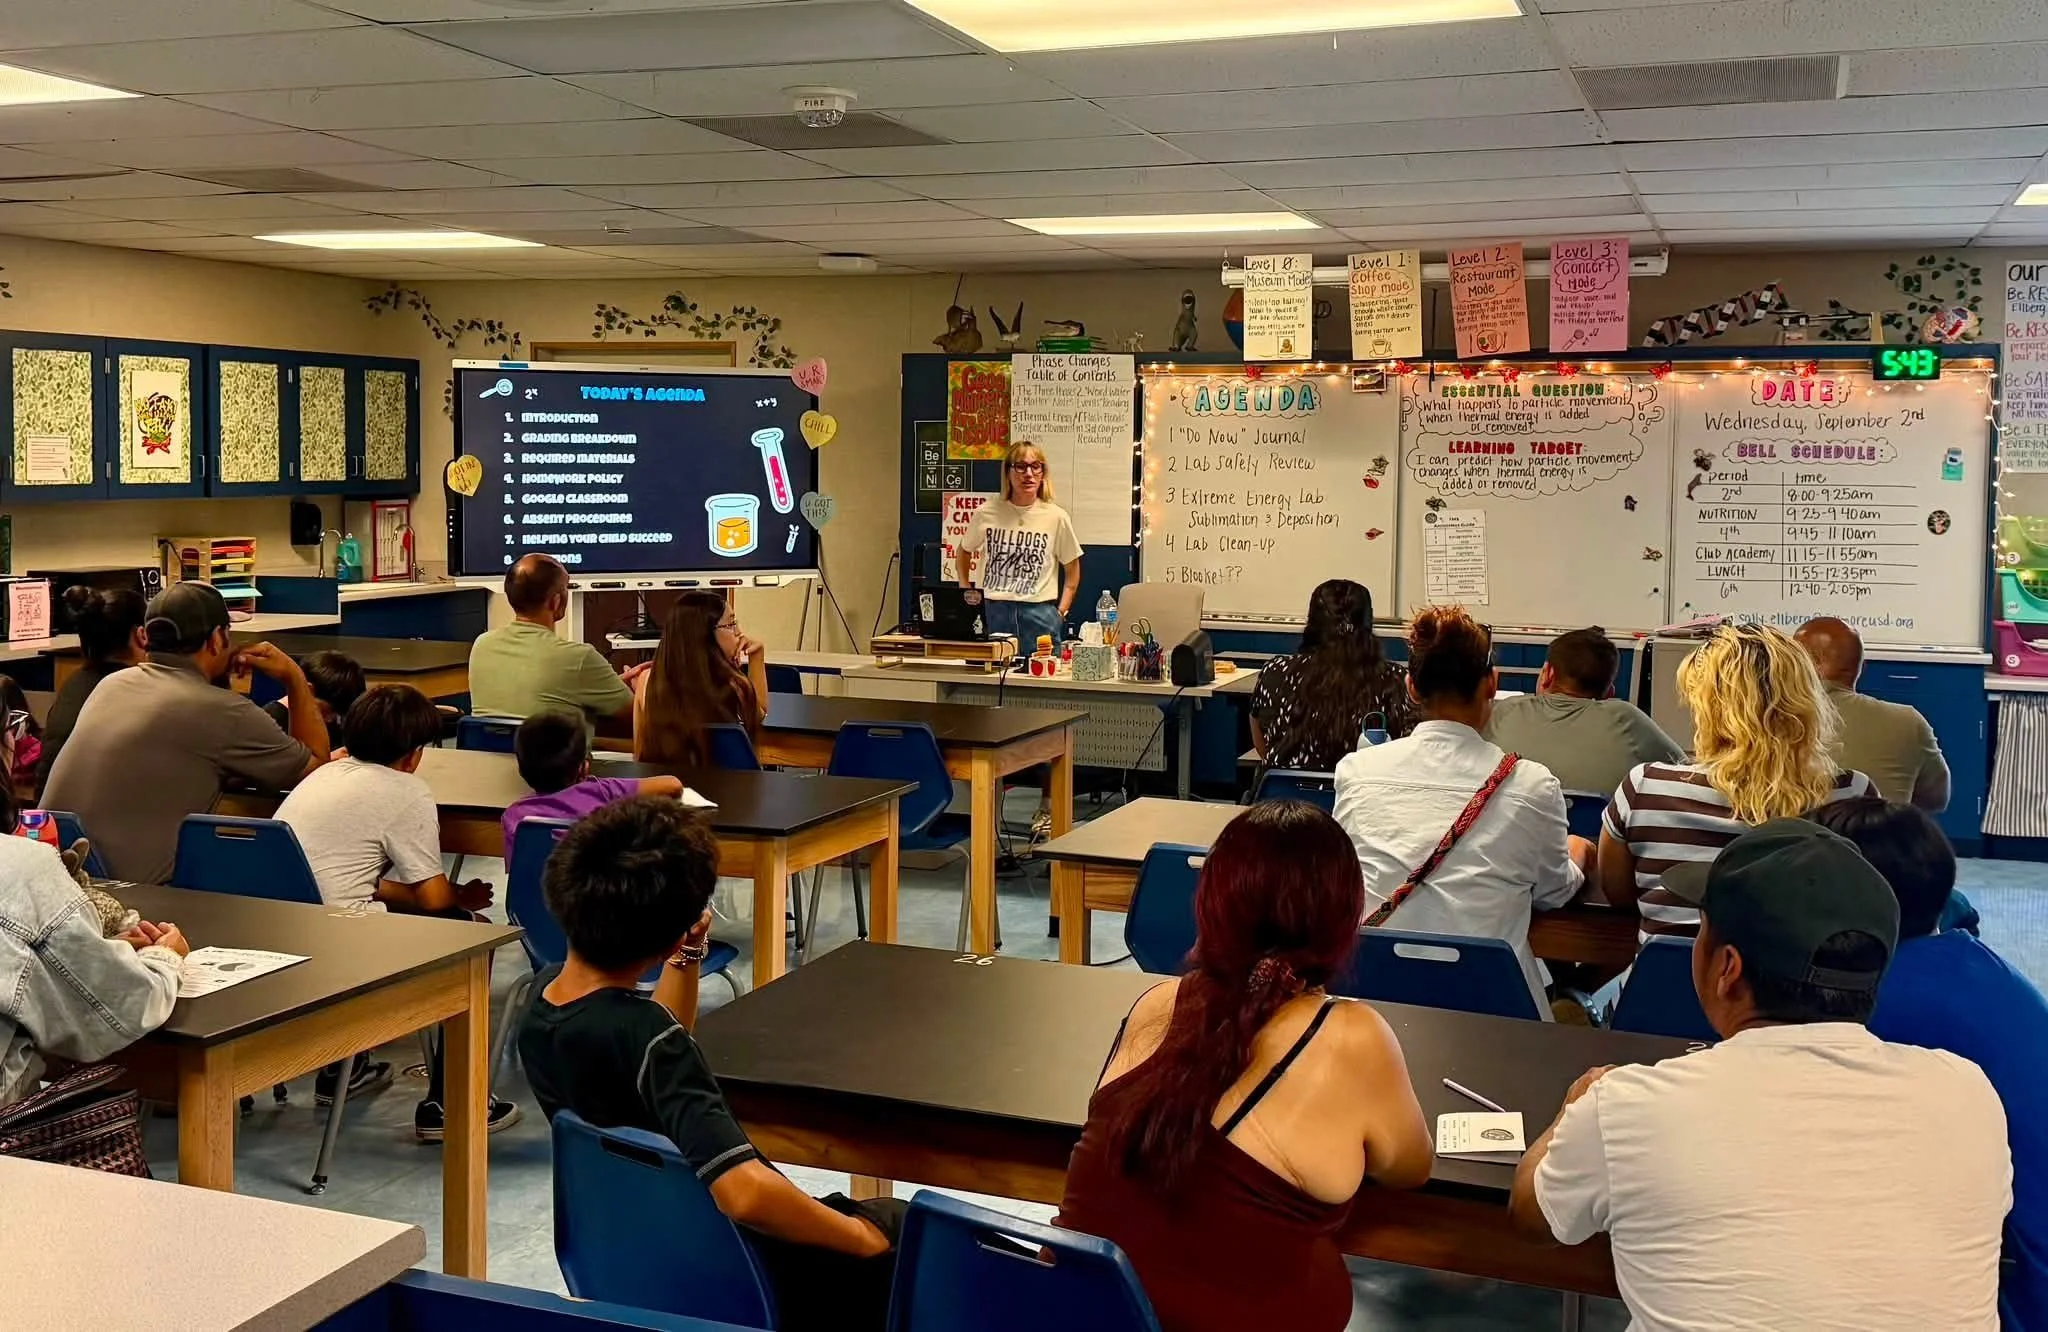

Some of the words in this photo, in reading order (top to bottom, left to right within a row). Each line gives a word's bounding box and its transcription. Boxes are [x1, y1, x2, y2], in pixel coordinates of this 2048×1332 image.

[1452, 250, 1486, 266] Level
[1496, 247, 1509, 261] 2:
[1557, 244, 1592, 259] Level
[1601, 242, 1616, 257] 3:
[1245, 257, 1275, 272] Level
[1352, 254, 1389, 269] Level
[1397, 253, 1411, 267] 1:
[1562, 260, 1614, 274] Concert
[1247, 275, 1285, 287] Museum
[1288, 274, 1311, 287] Mode
[1352, 271, 1391, 283] Coffee
[1453, 266, 1516, 284] Restaurant
[1568, 276, 1595, 289] Mode
[1352, 285, 1376, 296] Shop
[1381, 281, 1409, 293] mode
[1468, 283, 1494, 297] Mode
[2008, 287, 2025, 300] Be
[2006, 322, 2023, 338] Be
[1033, 355, 1064, 368] Phase
[1069, 355, 1111, 370] Changes
[812, 366, 820, 375] R
[1025, 369, 1054, 380] Table
[1058, 369, 1068, 381] of
[1073, 369, 1116, 382] Contents
[2005, 372, 2020, 387] Be
[581, 386, 643, 400] TODAY'S
[645, 388, 705, 401] AGENDA
[1442, 384, 1521, 398] ESSENTIAL
[1762, 379, 1843, 402] DATE:
[1423, 399, 1450, 412] What
[1458, 398, 1501, 412] happens
[1508, 399, 1518, 410] to
[1522, 397, 1564, 410] particle
[1570, 395, 1628, 407] movement
[505, 413, 513, 423] 1.
[521, 412, 599, 424] INTRODUCTION
[1012, 411, 1017, 422] 3
[1426, 412, 1452, 423] when
[1459, 410, 1500, 422] thermal
[1506, 411, 1539, 424] energy
[1545, 411, 1552, 420] is
[1559, 409, 1590, 419] added
[1815, 412, 1892, 431] September
[1900, 408, 1926, 427] 2nd
[805, 418, 831, 433] CHILL
[1471, 422, 1481, 431] or
[503, 433, 514, 443] 2.
[521, 433, 569, 444] GRADING
[571, 434, 637, 444] BREAKDOWN
[1253, 427, 1306, 445] Journal
[925, 450, 939, 460] Be
[1448, 441, 1515, 455] LEARNING
[1737, 444, 1776, 458] BELL
[1791, 444, 1884, 461] SCHEDULE:
[503, 453, 514, 463] 3.
[521, 453, 575, 464] REQUIRED
[577, 454, 635, 464] MATERIALS
[1168, 457, 1176, 473] 2
[1185, 455, 1210, 471] Lab
[1269, 453, 1316, 470] Review
[1416, 455, 1424, 465] I
[1430, 456, 1450, 466] can
[1458, 455, 1492, 467] predict
[1501, 455, 1523, 467] how
[1528, 456, 1571, 467] particle
[1576, 452, 1634, 465] movement
[522, 474, 586, 485] HOMEWORK
[588, 474, 624, 484] POLICY
[927, 474, 937, 484] Ni
[946, 474, 961, 484] Ce
[1419, 468, 1458, 479] changes
[1464, 466, 1490, 477] when
[1497, 466, 1535, 478] thermal
[1540, 466, 1574, 480] energy
[1579, 465, 1587, 475] is
[1708, 469, 1748, 484] period
[1796, 471, 1826, 484] time
[1442, 478, 1473, 490] added
[1477, 479, 1487, 490] or
[1493, 478, 1537, 491] removed
[504, 494, 514, 504] 5.
[522, 494, 564, 504] GOOGLE
[566, 494, 628, 503] CLASSROOM
[1166, 488, 1175, 504] 3
[1182, 489, 1236, 505] Extreme
[1247, 490, 1291, 510] Energy
[1299, 488, 1324, 504] Lab
[1722, 486, 1742, 501] 2nd
[814, 499, 832, 508] GOT
[504, 514, 514, 524] 6.
[522, 514, 564, 524] ABSENT
[565, 514, 632, 524] PROCEDURES
[806, 508, 828, 518] THIS
[1188, 511, 1258, 528] Sublimation
[1277, 511, 1339, 529] Deposition
[1699, 508, 1758, 521] NUTRITION
[505, 535, 514, 544] 7.
[522, 534, 568, 544] HELPING
[569, 534, 597, 544] YOUR
[599, 534, 627, 543] CHILD
[629, 533, 672, 543] SUCCEED
[987, 528, 1048, 549] BULLDOGS
[1719, 524, 1740, 538] 4th
[1165, 534, 1175, 552] 4
[1185, 536, 1208, 551] Lab
[1695, 547, 1722, 560] Club
[1726, 547, 1775, 563] Academy
[1166, 568, 1175, 583] 5
[1708, 565, 1746, 577] LUNCH
[1720, 582, 1738, 599] 6th
